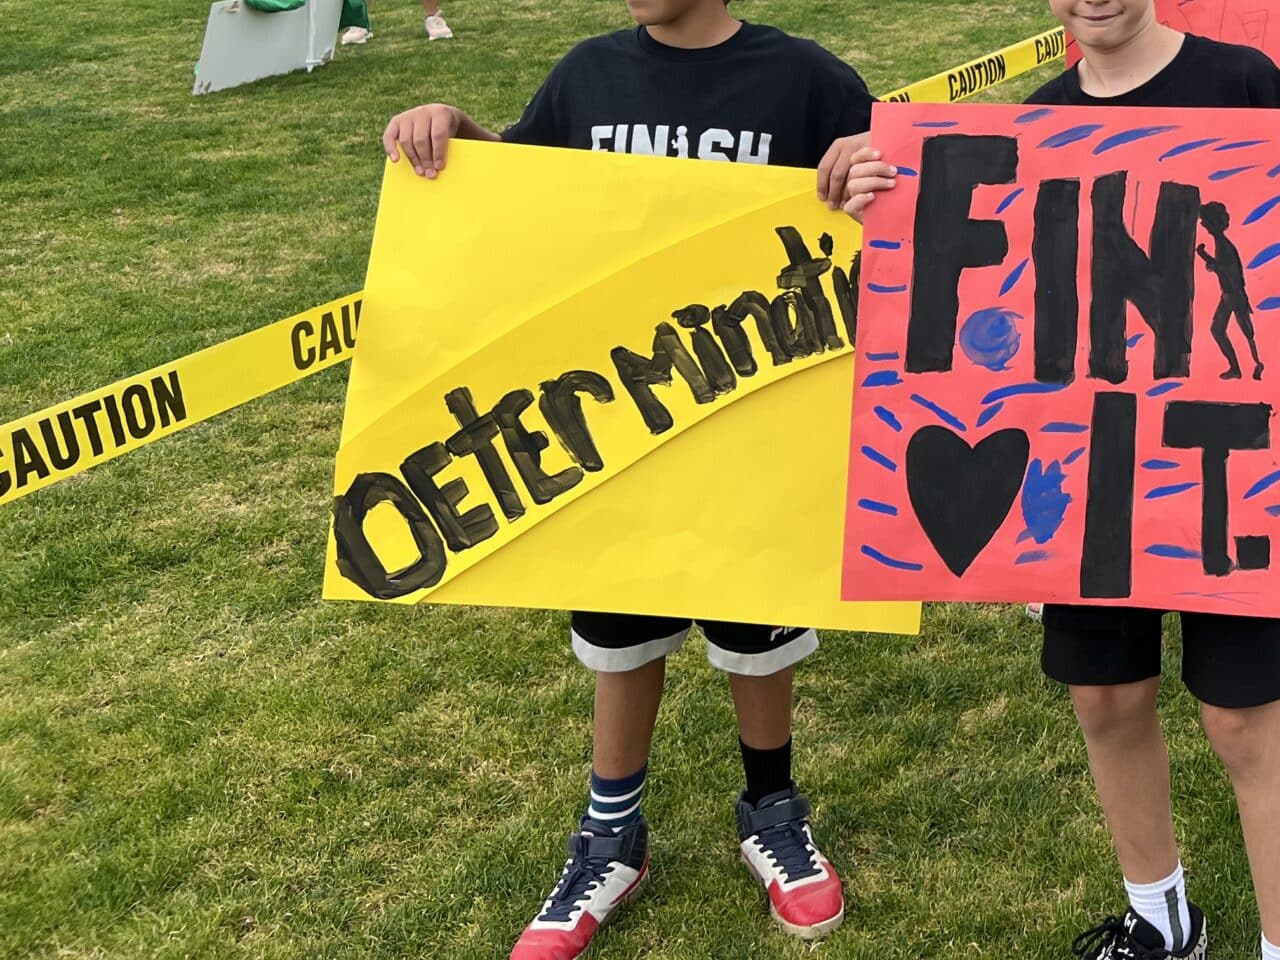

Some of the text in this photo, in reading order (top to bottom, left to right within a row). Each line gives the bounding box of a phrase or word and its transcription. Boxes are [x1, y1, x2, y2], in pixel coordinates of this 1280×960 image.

[948, 54, 1006, 102] CAUTION
[591, 124, 772, 165] FINISH
[1080, 392, 1276, 599] IT.
